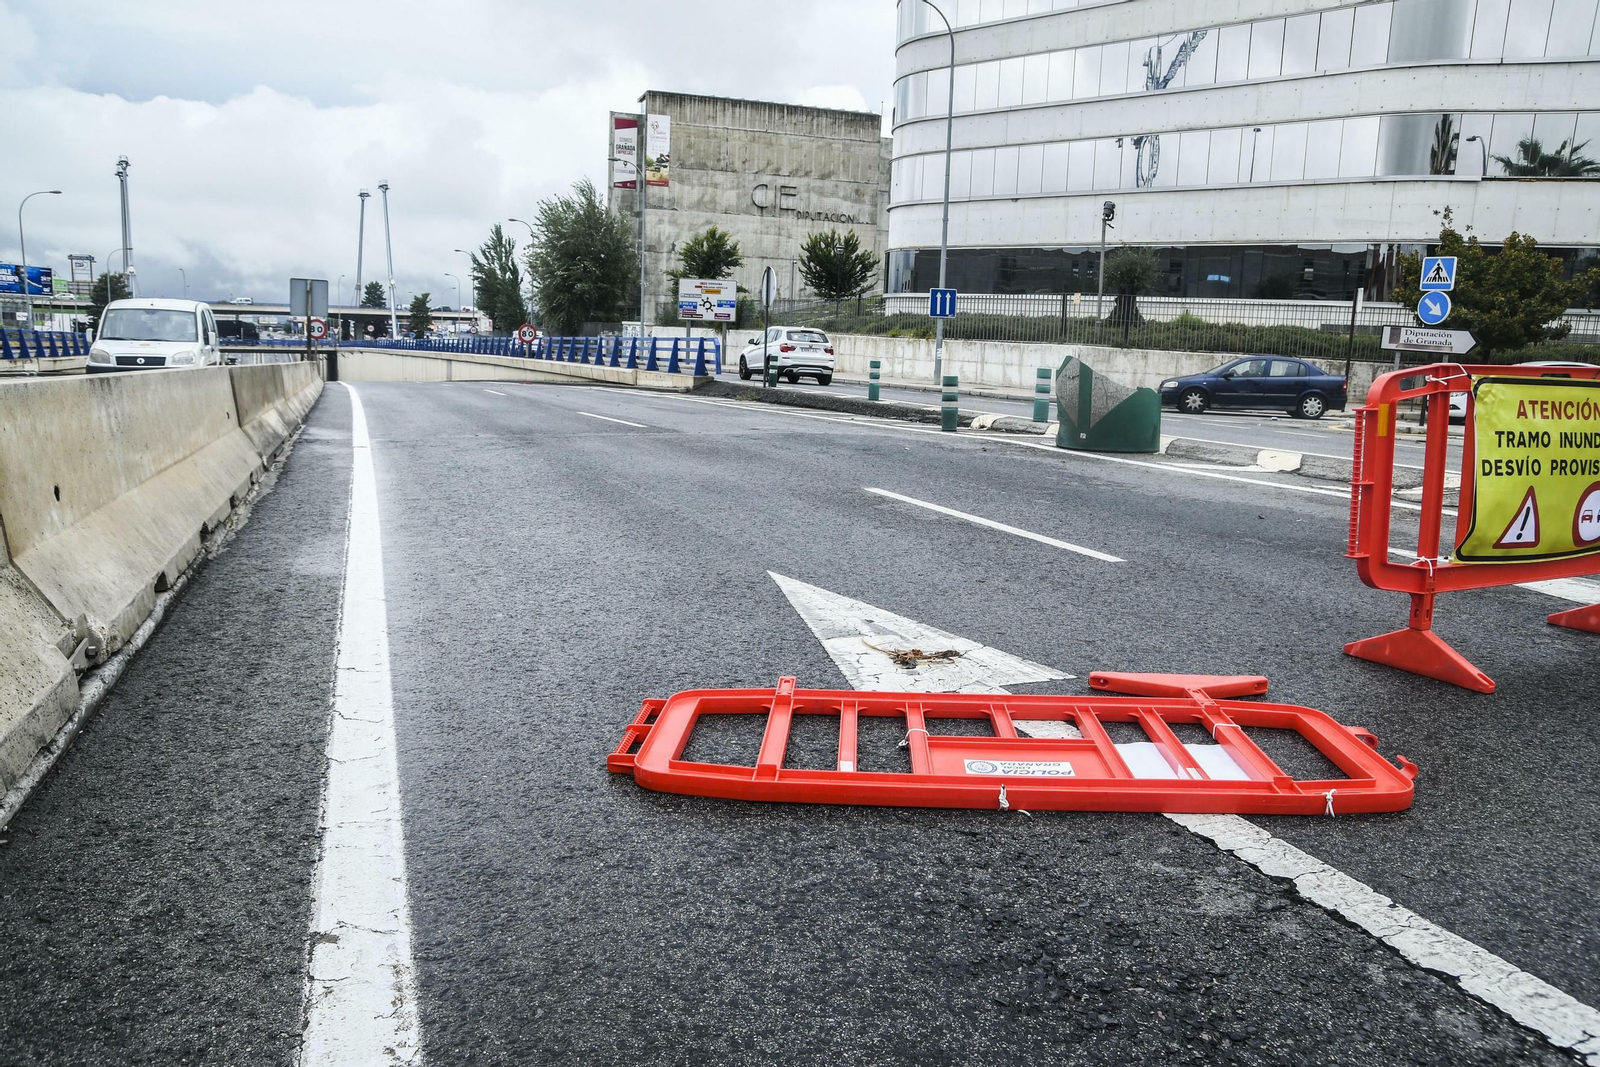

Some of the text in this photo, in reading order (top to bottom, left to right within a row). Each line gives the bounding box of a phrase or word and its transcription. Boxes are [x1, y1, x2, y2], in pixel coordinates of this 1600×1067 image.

[796, 210, 855, 223] DIPUTACION
[521, 330, 534, 338] 80
[1404, 329, 1453, 339] Diputación
[1415, 337, 1453, 346] Granada
[1516, 397, 1600, 421] ATENCIÓN
[1494, 430, 1600, 449] TRAMO INUND
[1481, 455, 1600, 477] DESVÍO PROVIS
